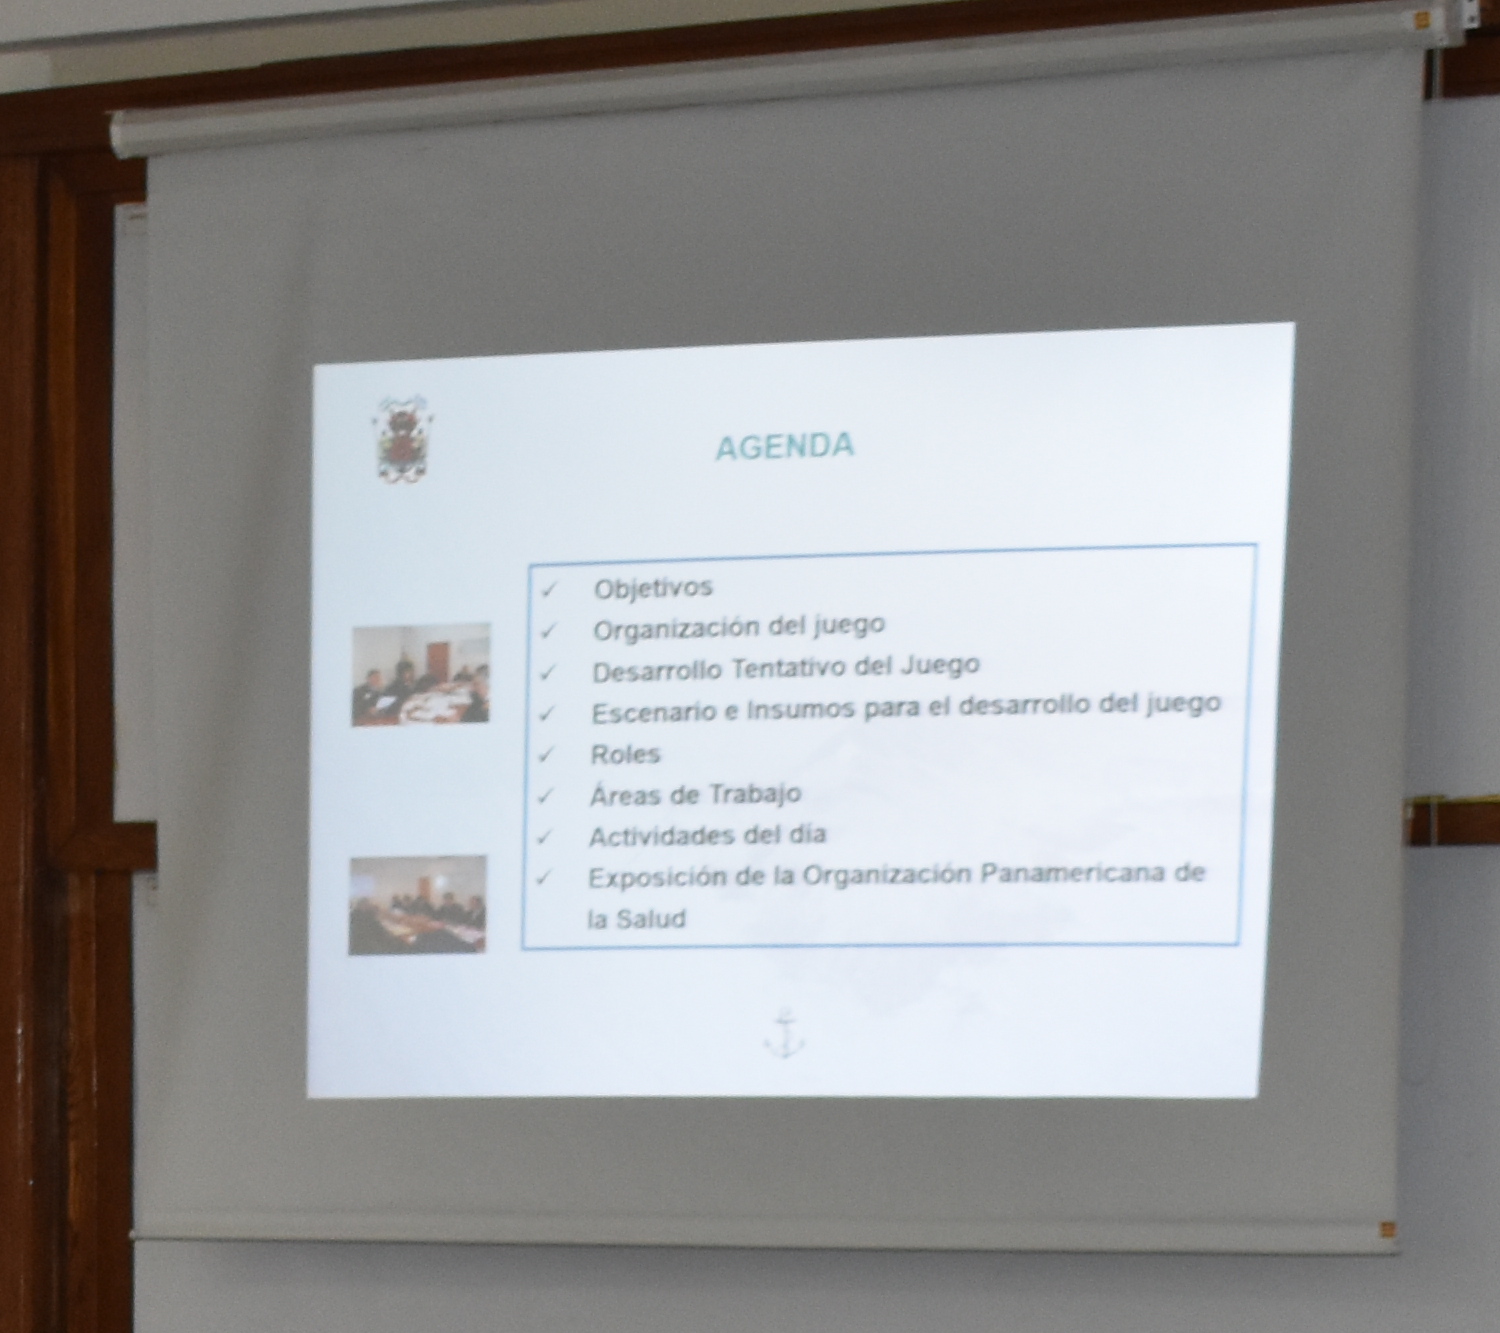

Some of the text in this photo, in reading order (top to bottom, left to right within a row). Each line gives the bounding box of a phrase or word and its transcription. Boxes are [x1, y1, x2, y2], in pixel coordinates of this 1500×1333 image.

[714, 430, 856, 462] AGENDA
[593, 578, 714, 605] Objetivos
[593, 614, 886, 646] Organización del juego
[592, 654, 981, 684] Desarrollo Tentativo del Juego
[591, 692, 1223, 725] Escenario e Insumos para el desarrollo del juego
[590, 743, 662, 765] Roles
[589, 781, 803, 809] Áreas de Trabajo
[588, 823, 828, 848] Actividades del día
[588, 861, 1207, 893] Exposición de la Organización Panamericana de
[587, 908, 687, 931] la Salud
